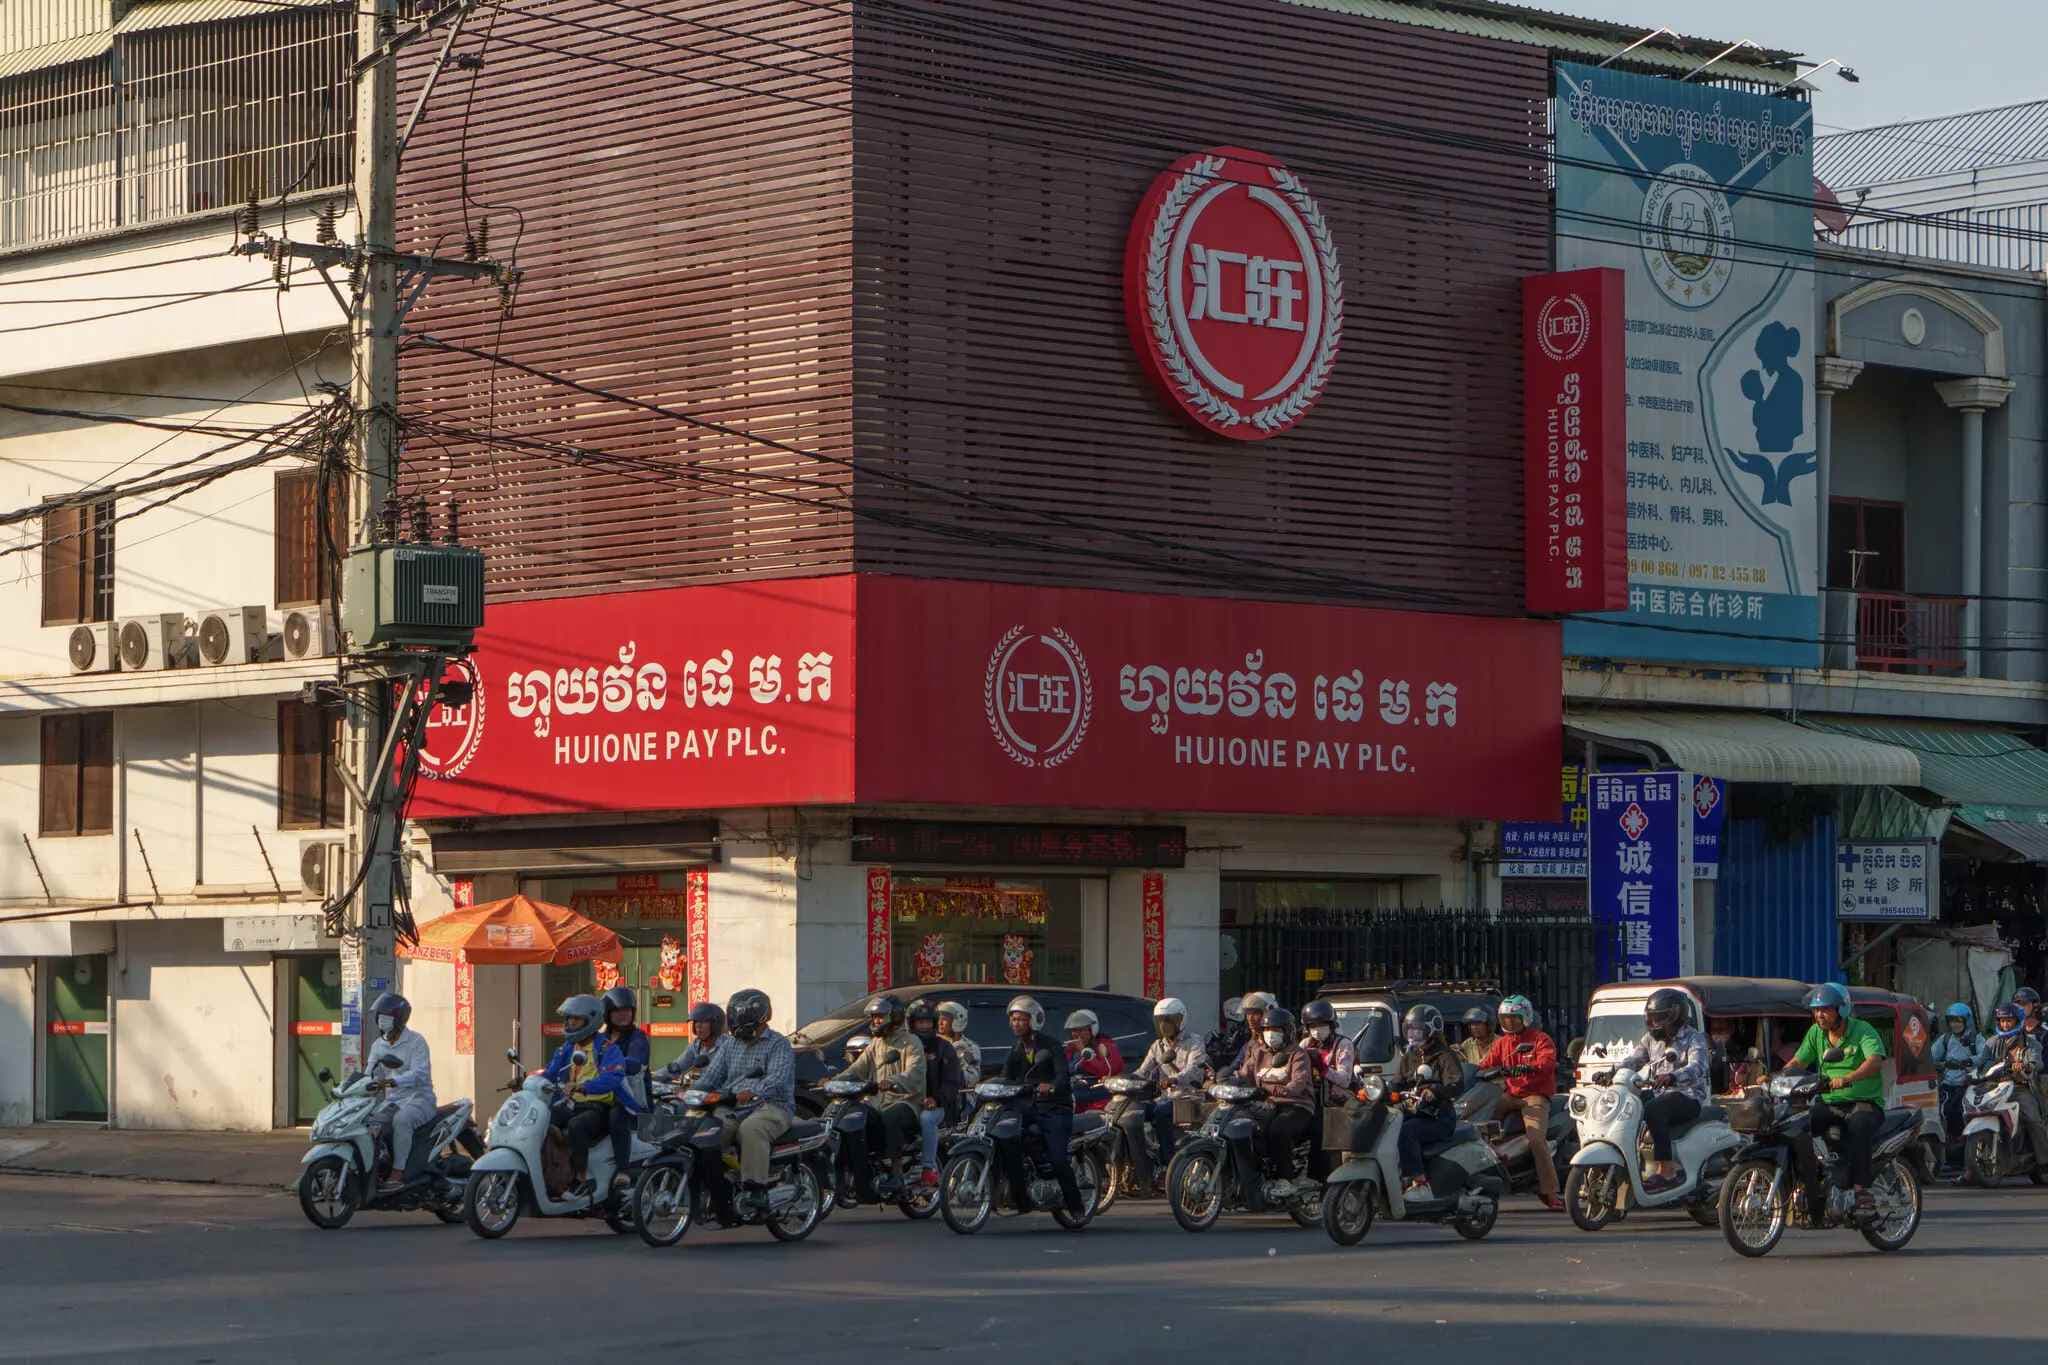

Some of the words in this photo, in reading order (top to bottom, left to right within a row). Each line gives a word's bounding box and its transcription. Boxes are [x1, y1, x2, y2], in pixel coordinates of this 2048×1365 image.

[1188, 243, 1304, 331] 汇旺
[1548, 317, 1579, 338] 汇旺
[1547, 409, 1559, 478] HUIONE
[1547, 484, 1559, 521] PAY
[1547, 524, 1560, 563] PLC.
[1630, 587, 1763, 620] 中医院合作诊所
[507, 640, 667, 738] ហួយវ័ន
[1007, 670, 1071, 715] 汇旺
[1119, 650, 1297, 734] ហួយវ័ន
[554, 731, 657, 766] HUIONE
[665, 728, 719, 761] PAY
[726, 725, 787, 757] PLC.
[1175, 735, 1287, 768] HUIONE
[1296, 740, 1350, 770] PAY
[1358, 743, 1416, 774] PLC.
[1841, 877, 1925, 894] 中华诊所
